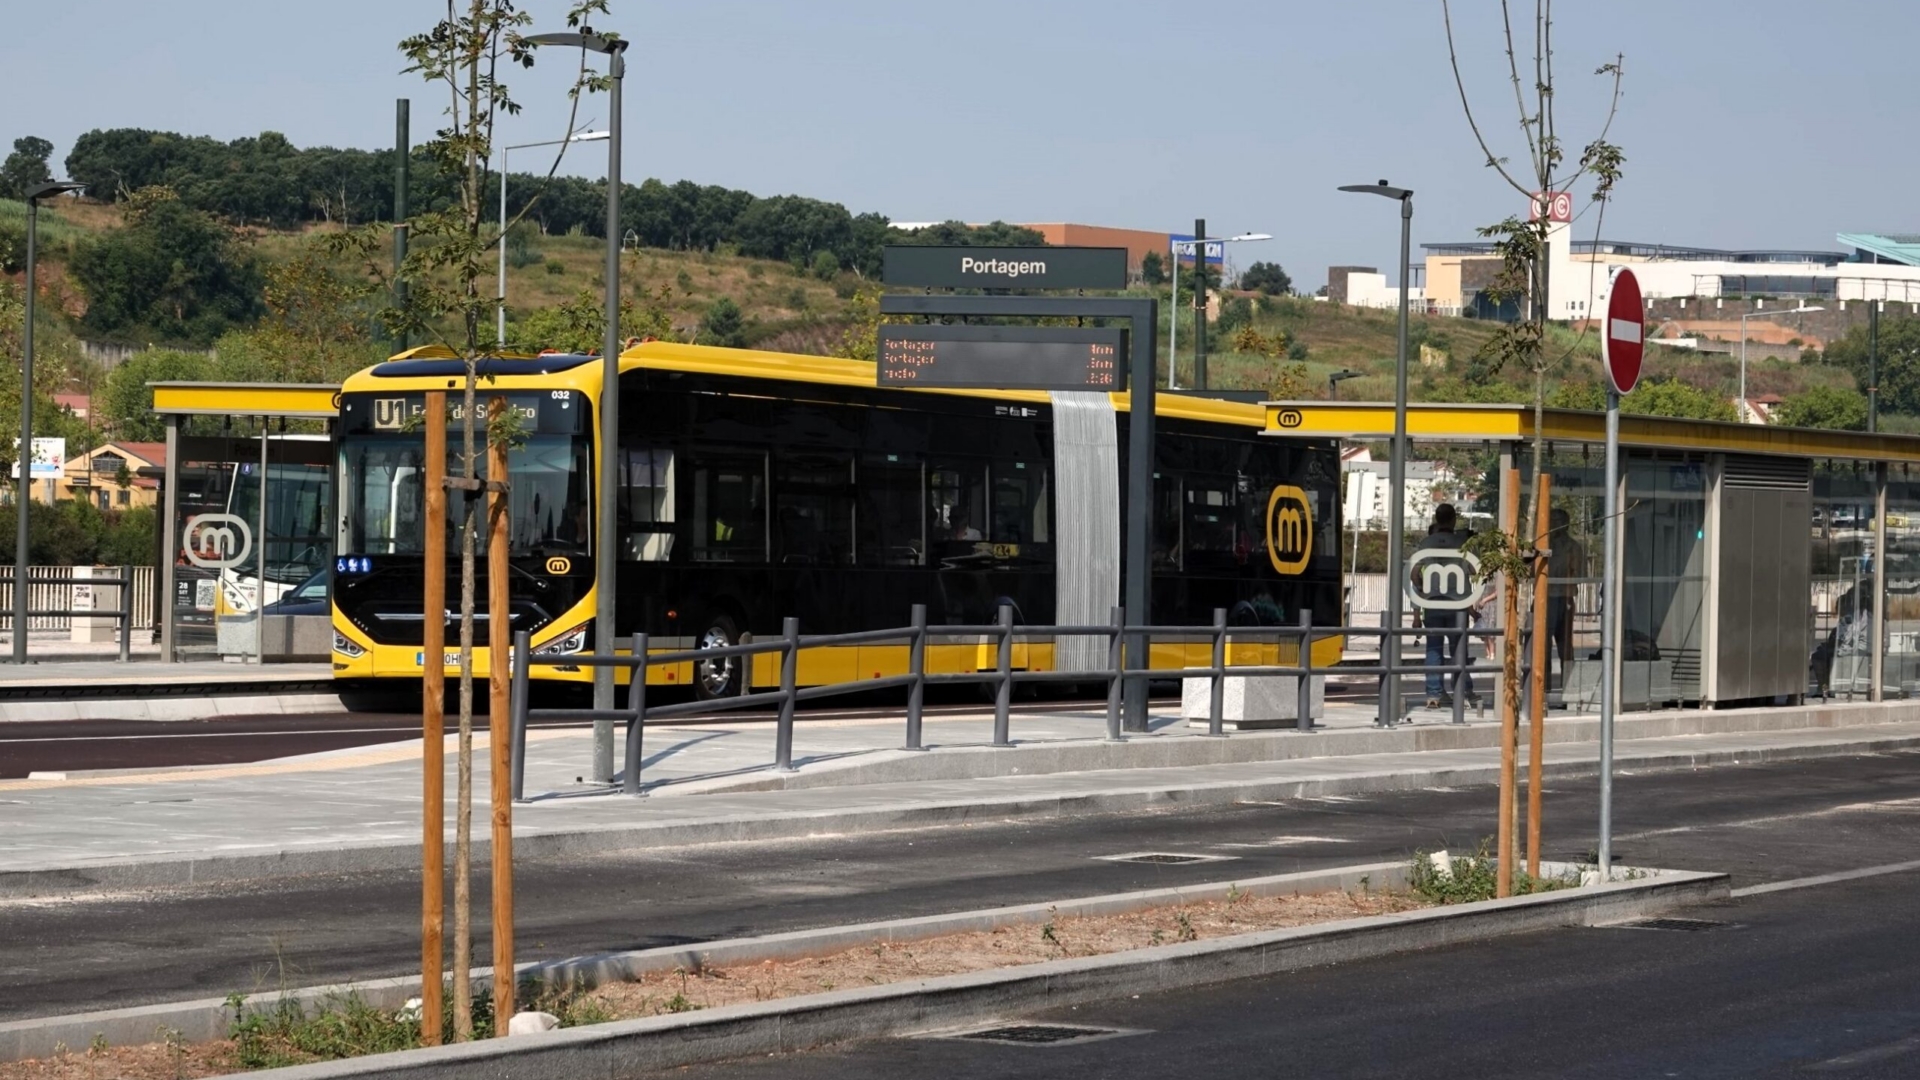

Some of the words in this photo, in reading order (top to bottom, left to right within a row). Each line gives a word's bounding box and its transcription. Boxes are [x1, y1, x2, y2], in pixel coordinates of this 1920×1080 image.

[961, 257, 1046, 278] Portagem
[551, 390, 570, 400] 032
[376, 400, 405, 426] U1
[178, 582, 189, 590] 28
